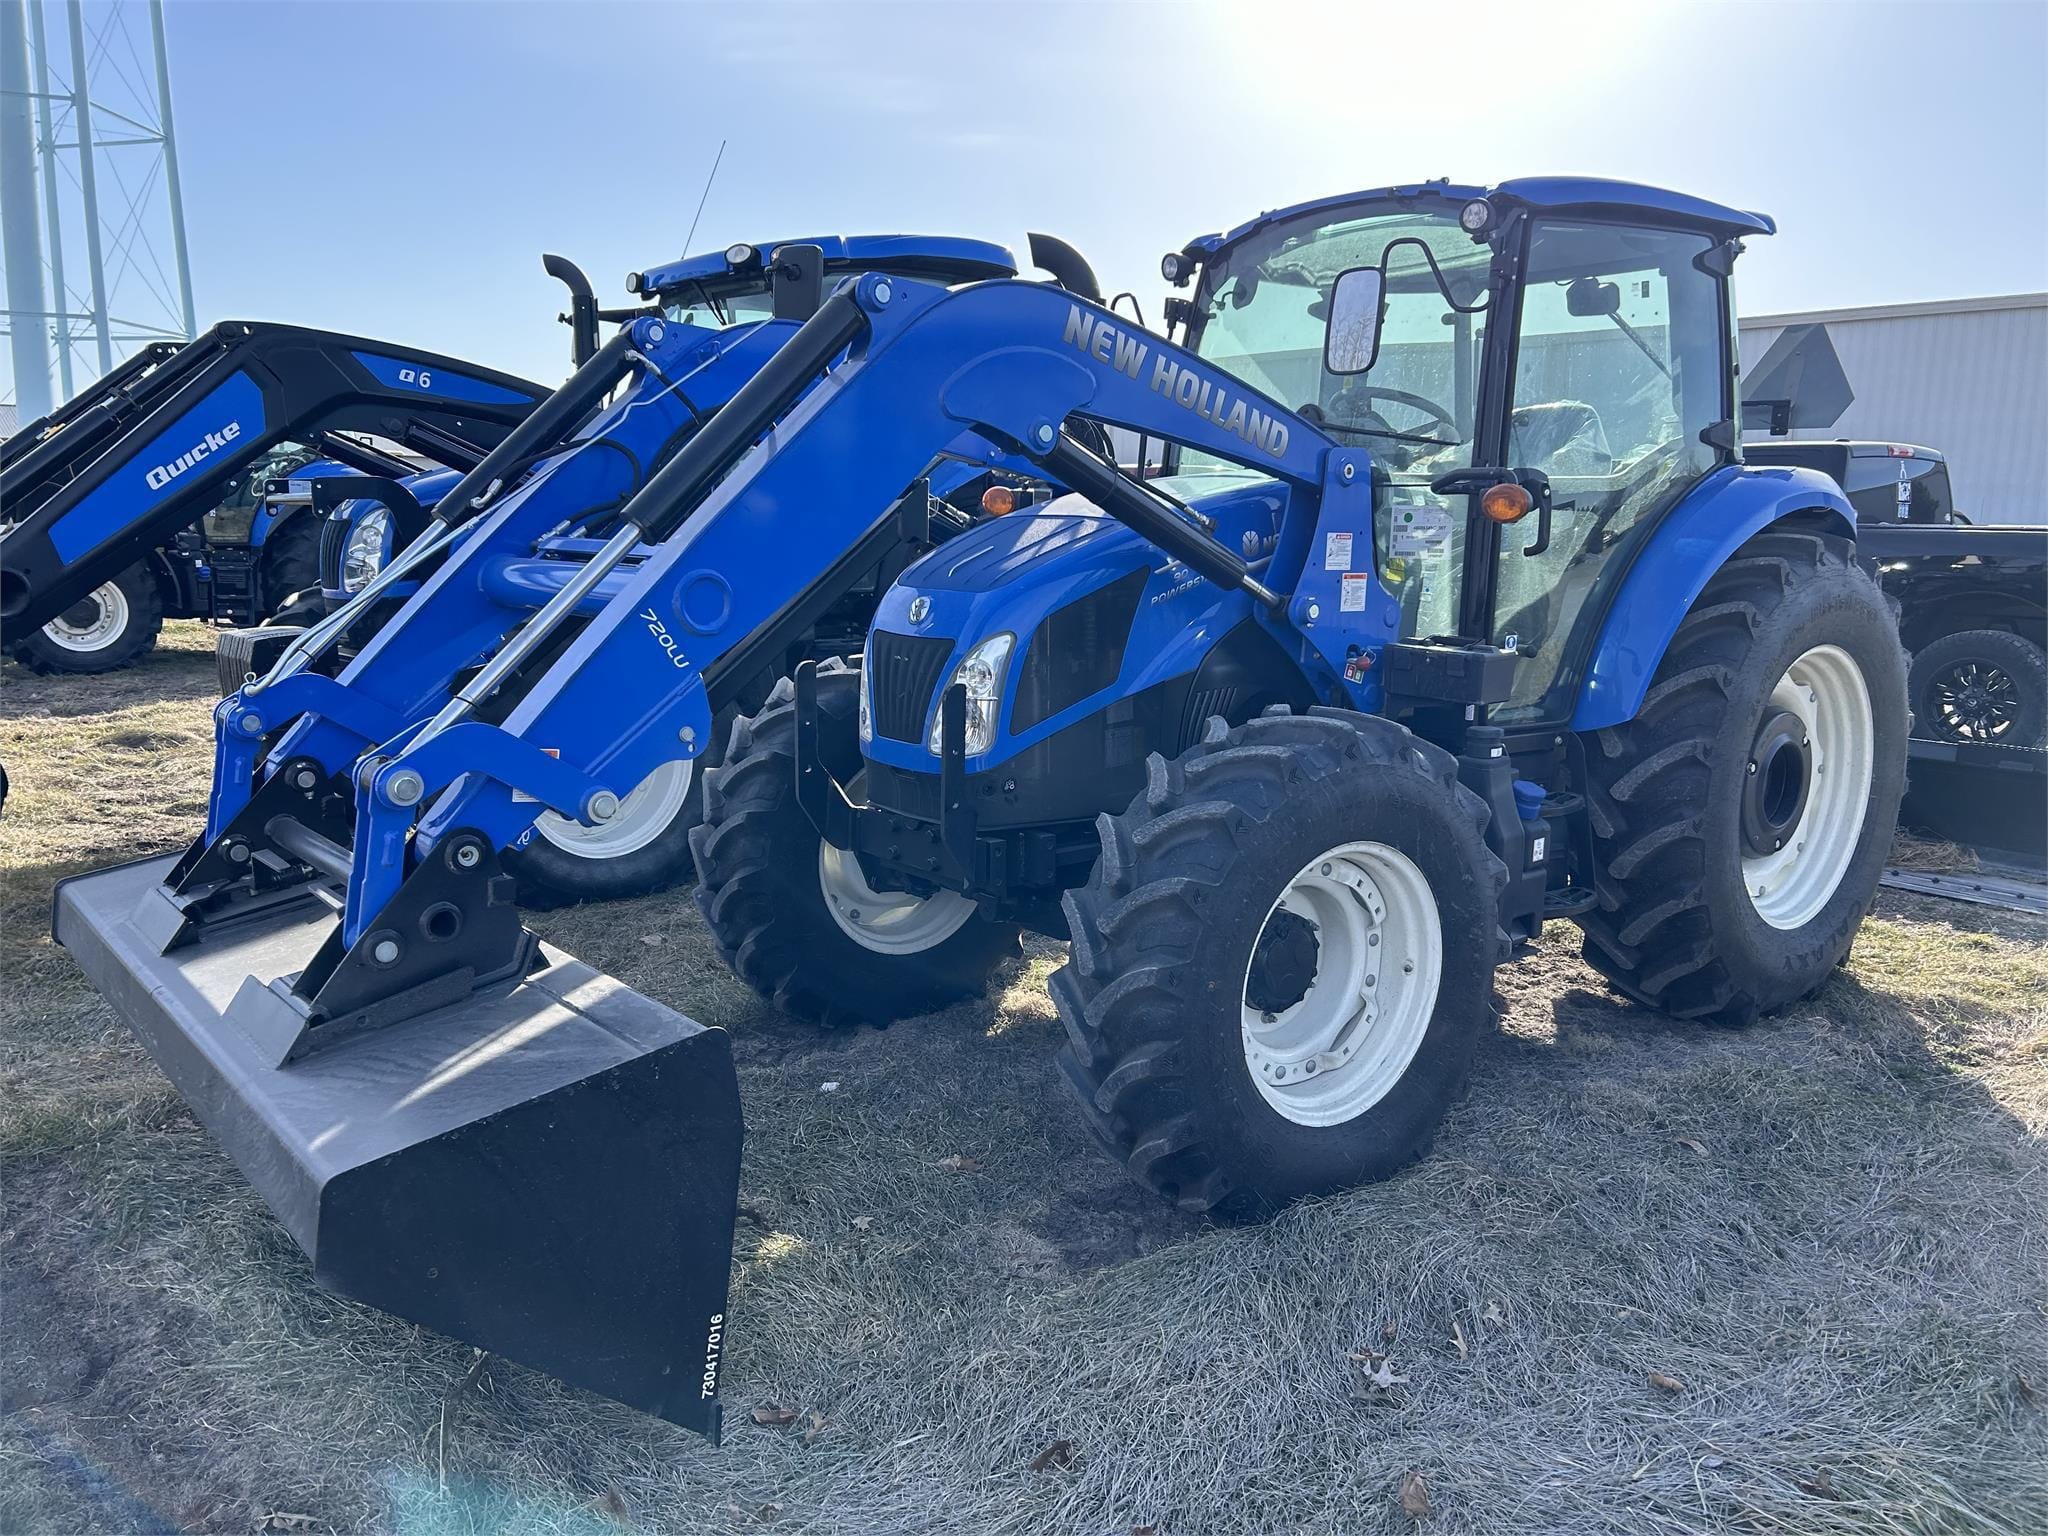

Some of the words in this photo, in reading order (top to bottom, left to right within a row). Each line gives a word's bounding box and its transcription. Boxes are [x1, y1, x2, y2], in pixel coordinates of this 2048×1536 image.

[1063, 303, 1148, 380] NEW
[1151, 353, 1290, 459] HOLLAND
[145, 421, 241, 490] Quicke
[1174, 568, 1189, 584] 90
[640, 607, 690, 668] 720LU
[701, 1313, 723, 1400] 730417016
